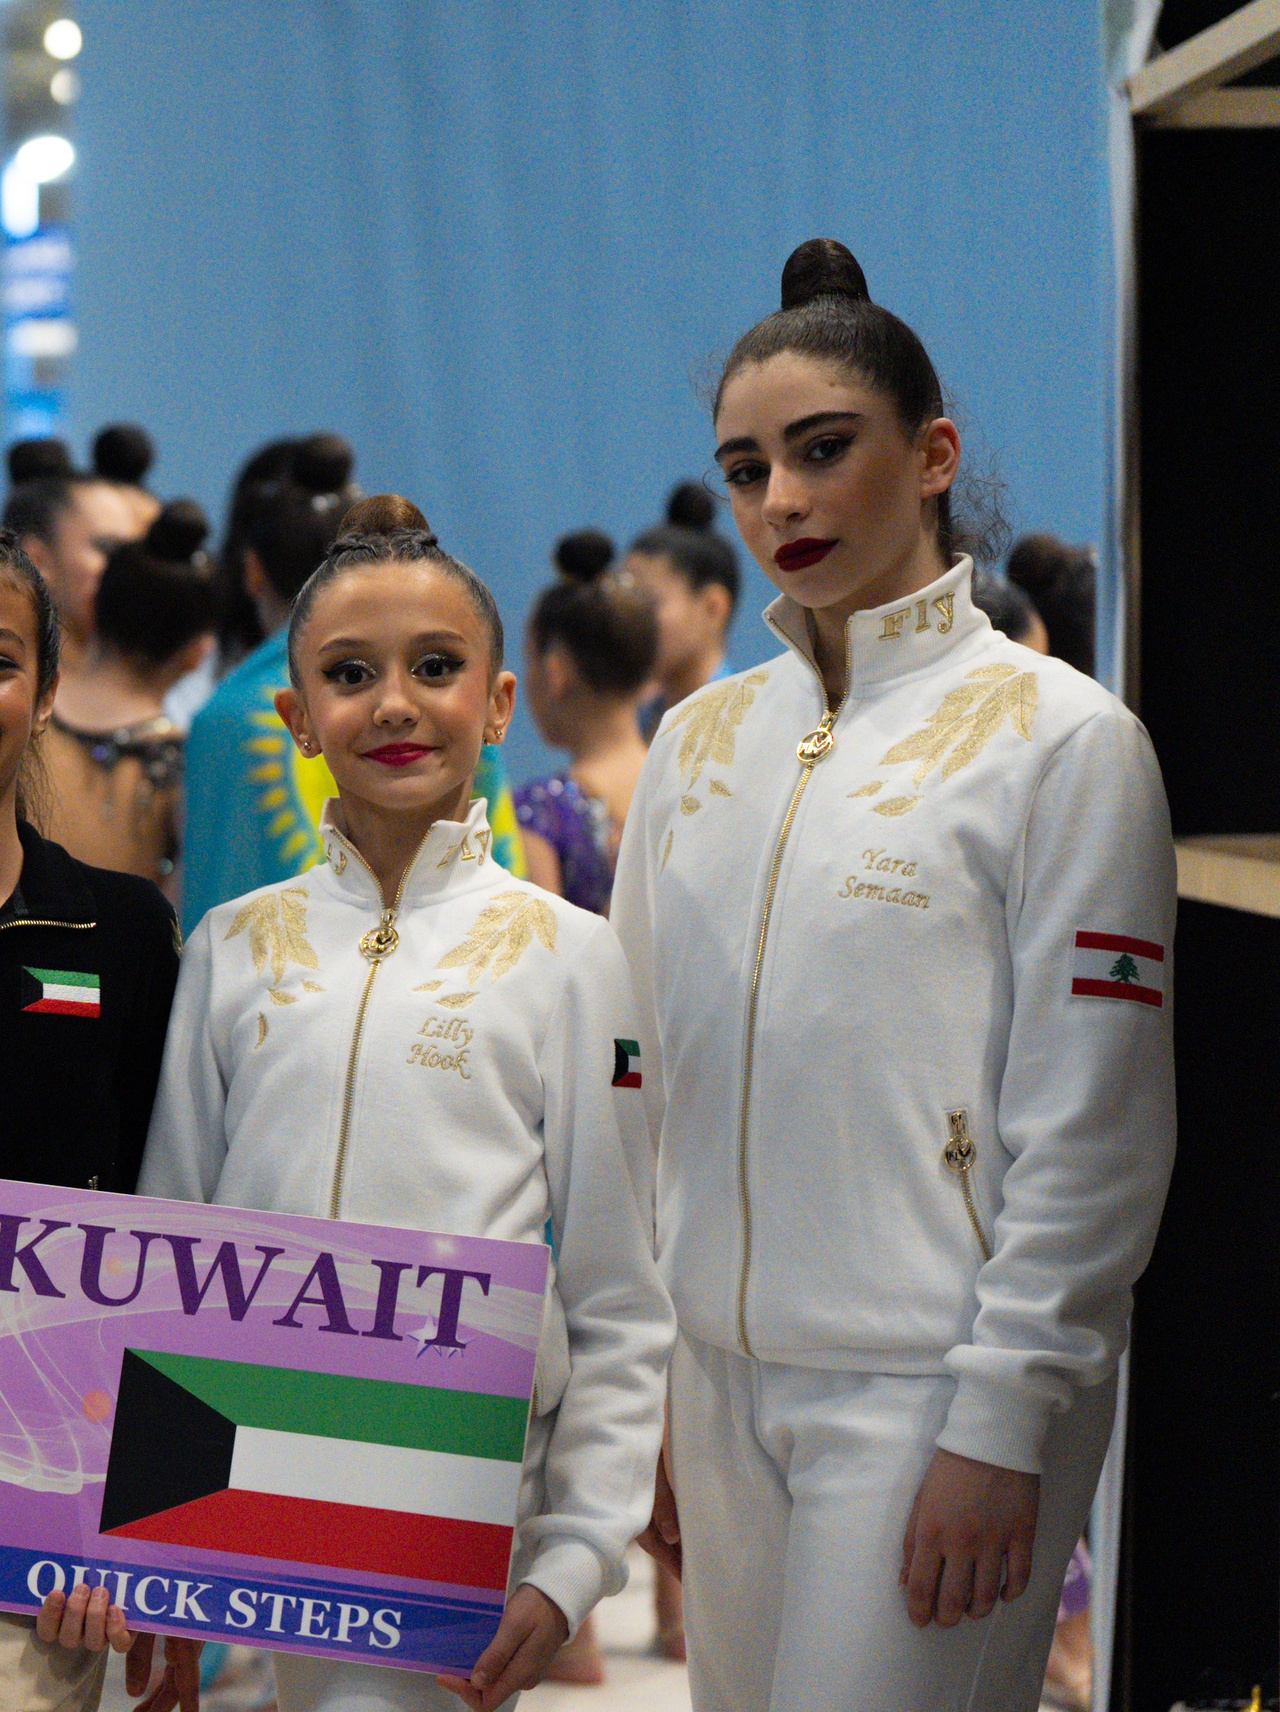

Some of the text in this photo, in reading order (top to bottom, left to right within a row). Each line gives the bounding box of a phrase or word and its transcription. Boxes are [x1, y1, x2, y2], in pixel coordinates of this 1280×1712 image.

[878, 592, 955, 641] Fly
[862, 848, 917, 877] Yara
[838, 875, 930, 910] Semaan
[416, 1017, 474, 1049] Lilly
[406, 1044, 472, 1080] Hook
[225, 1588, 402, 1649] STEPS
